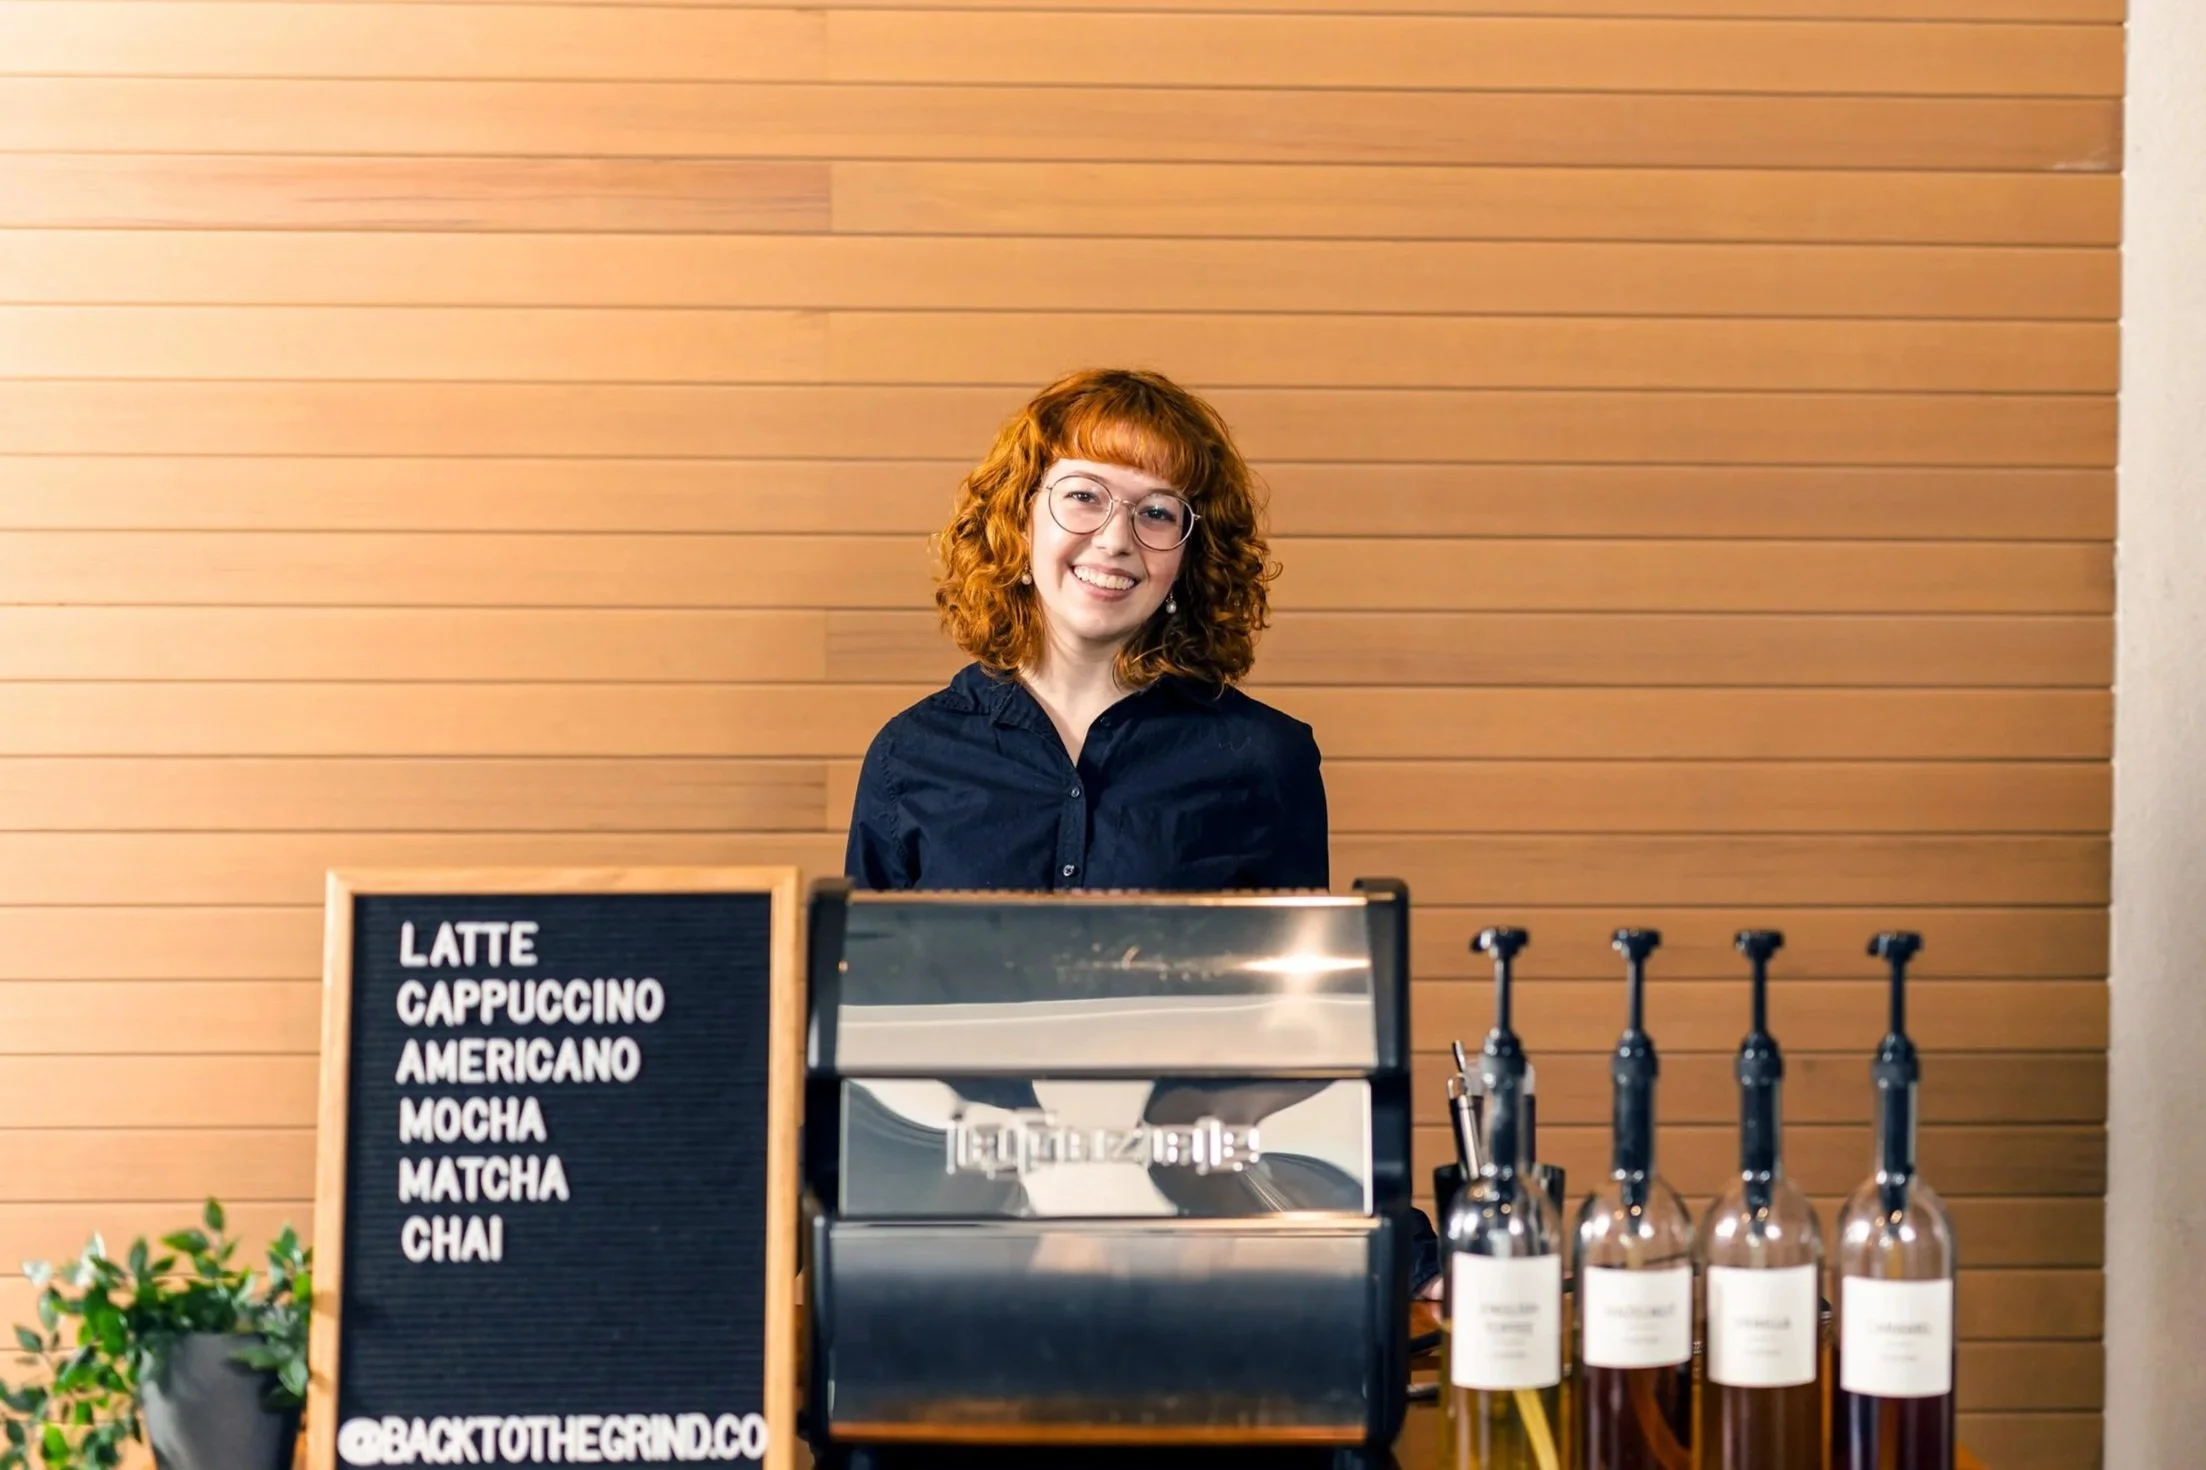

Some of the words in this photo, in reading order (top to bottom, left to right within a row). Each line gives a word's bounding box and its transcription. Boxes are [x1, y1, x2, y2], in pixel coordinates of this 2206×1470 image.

[399, 921, 540, 968] LATTE
[396, 978, 666, 1027] CAPPUCCINO
[395, 1036, 641, 1085] AMERICANO
[399, 1096, 547, 1144] MOCHA
[398, 1154, 570, 1203] MATCHA
[401, 1214, 503, 1263] CHAI
[337, 1412, 768, 1466] @BACKTOTHEGRIND.CO
